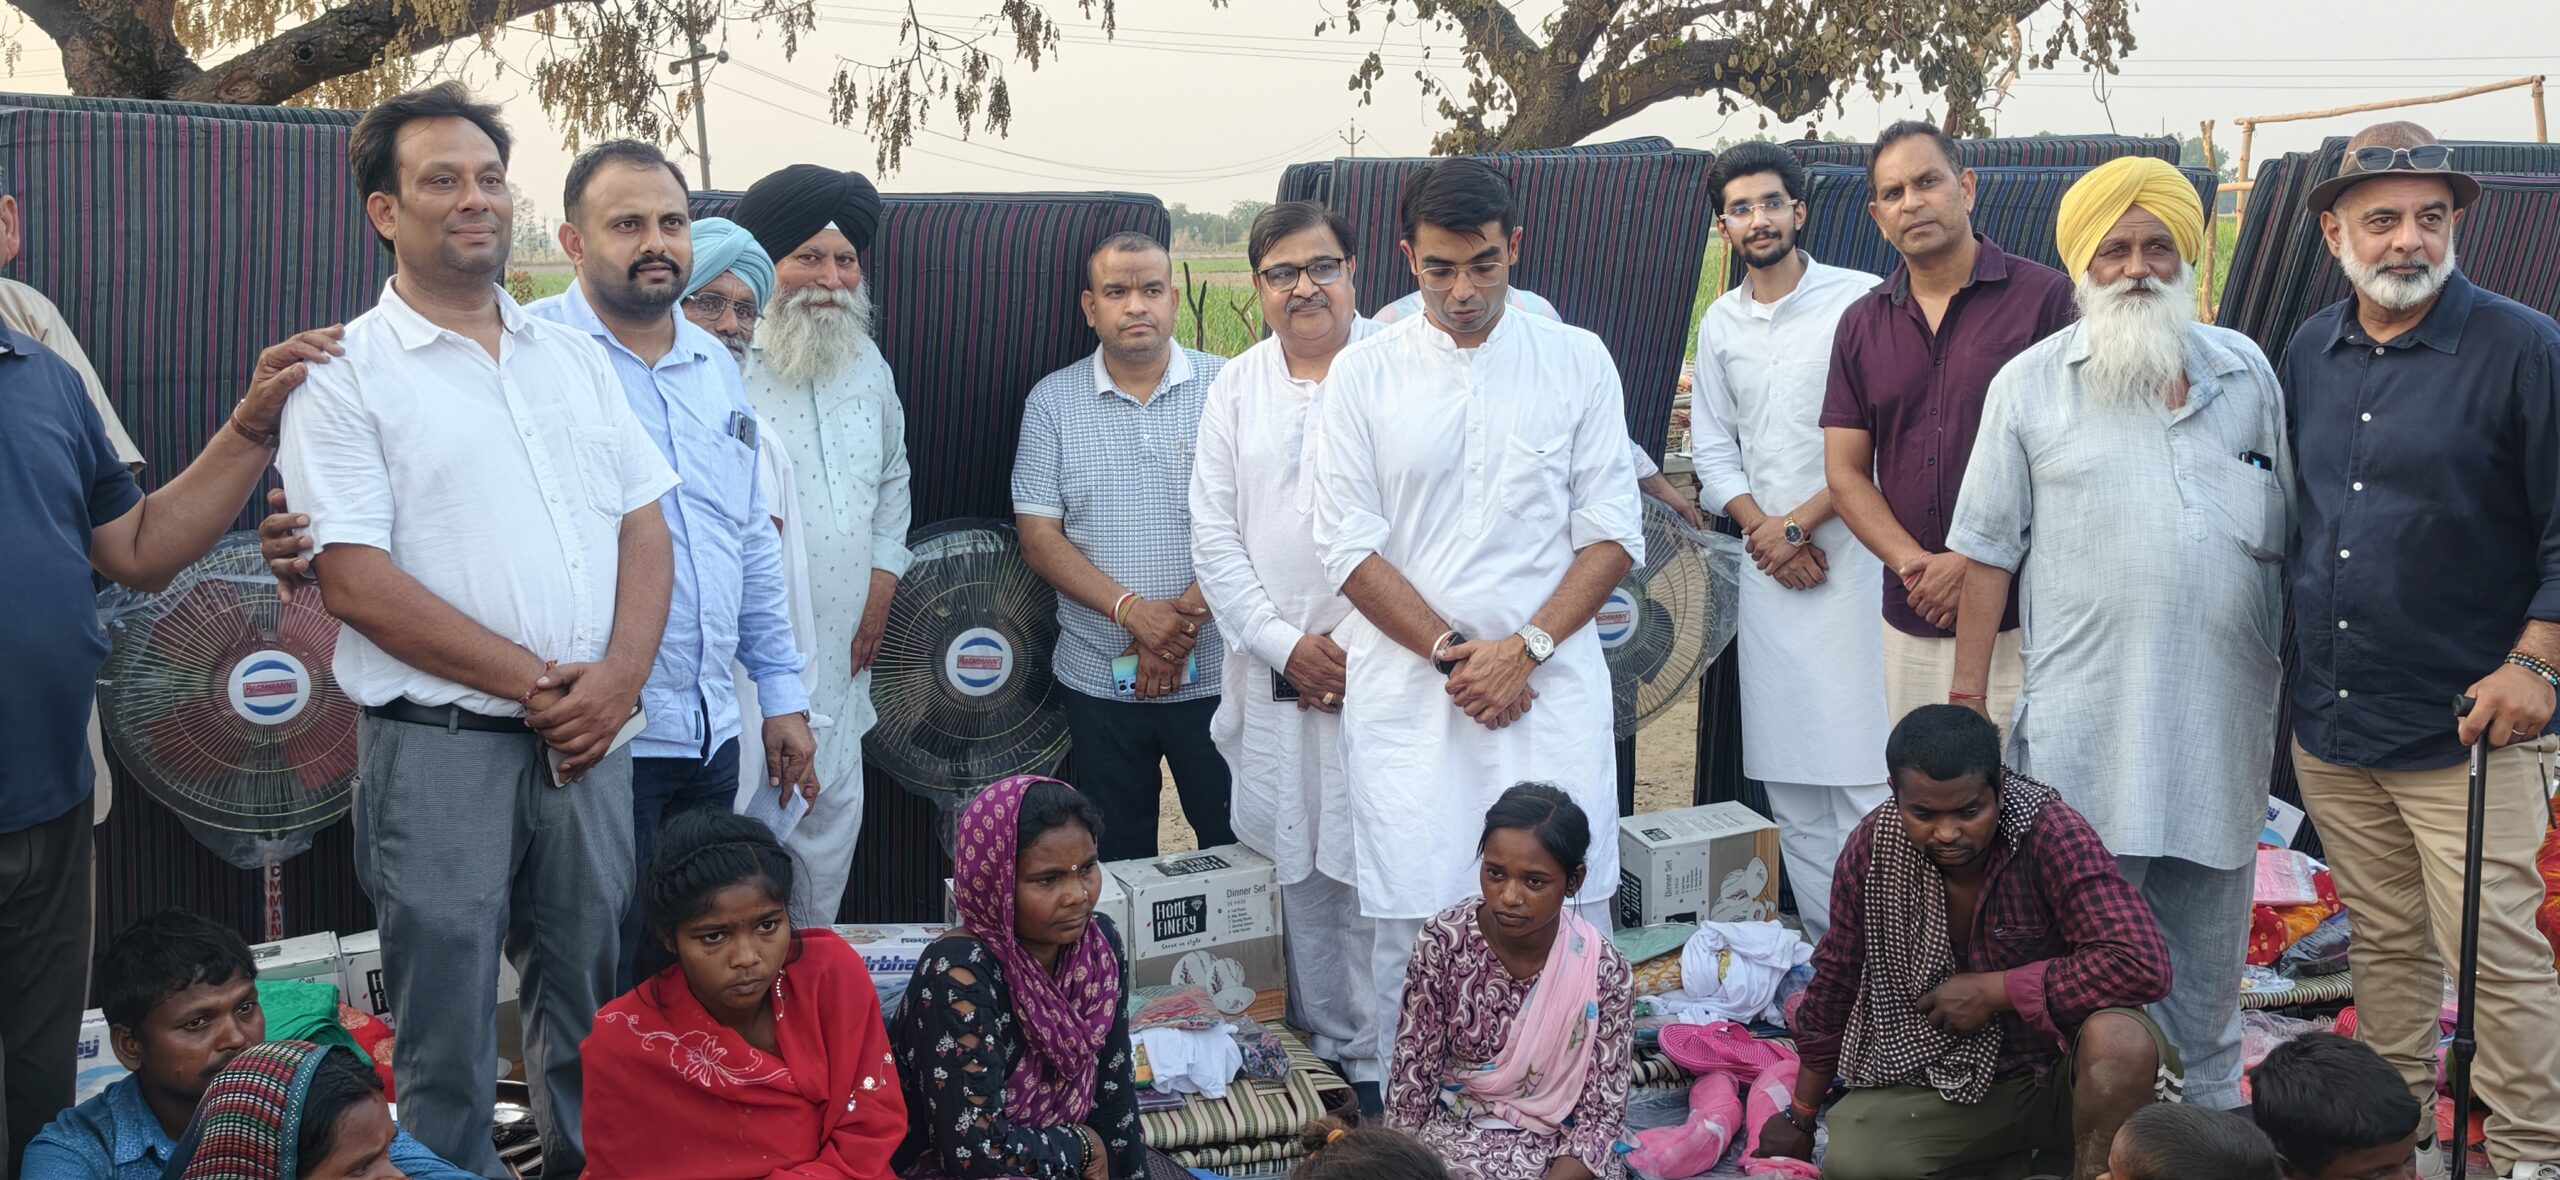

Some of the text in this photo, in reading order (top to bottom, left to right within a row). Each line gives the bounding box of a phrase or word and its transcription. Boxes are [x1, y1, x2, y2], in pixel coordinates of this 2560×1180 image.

[1226, 884, 1266, 898] Dinner Set
[1156, 900, 1188, 920] HOME
[1157, 915, 1197, 937] FINERY
